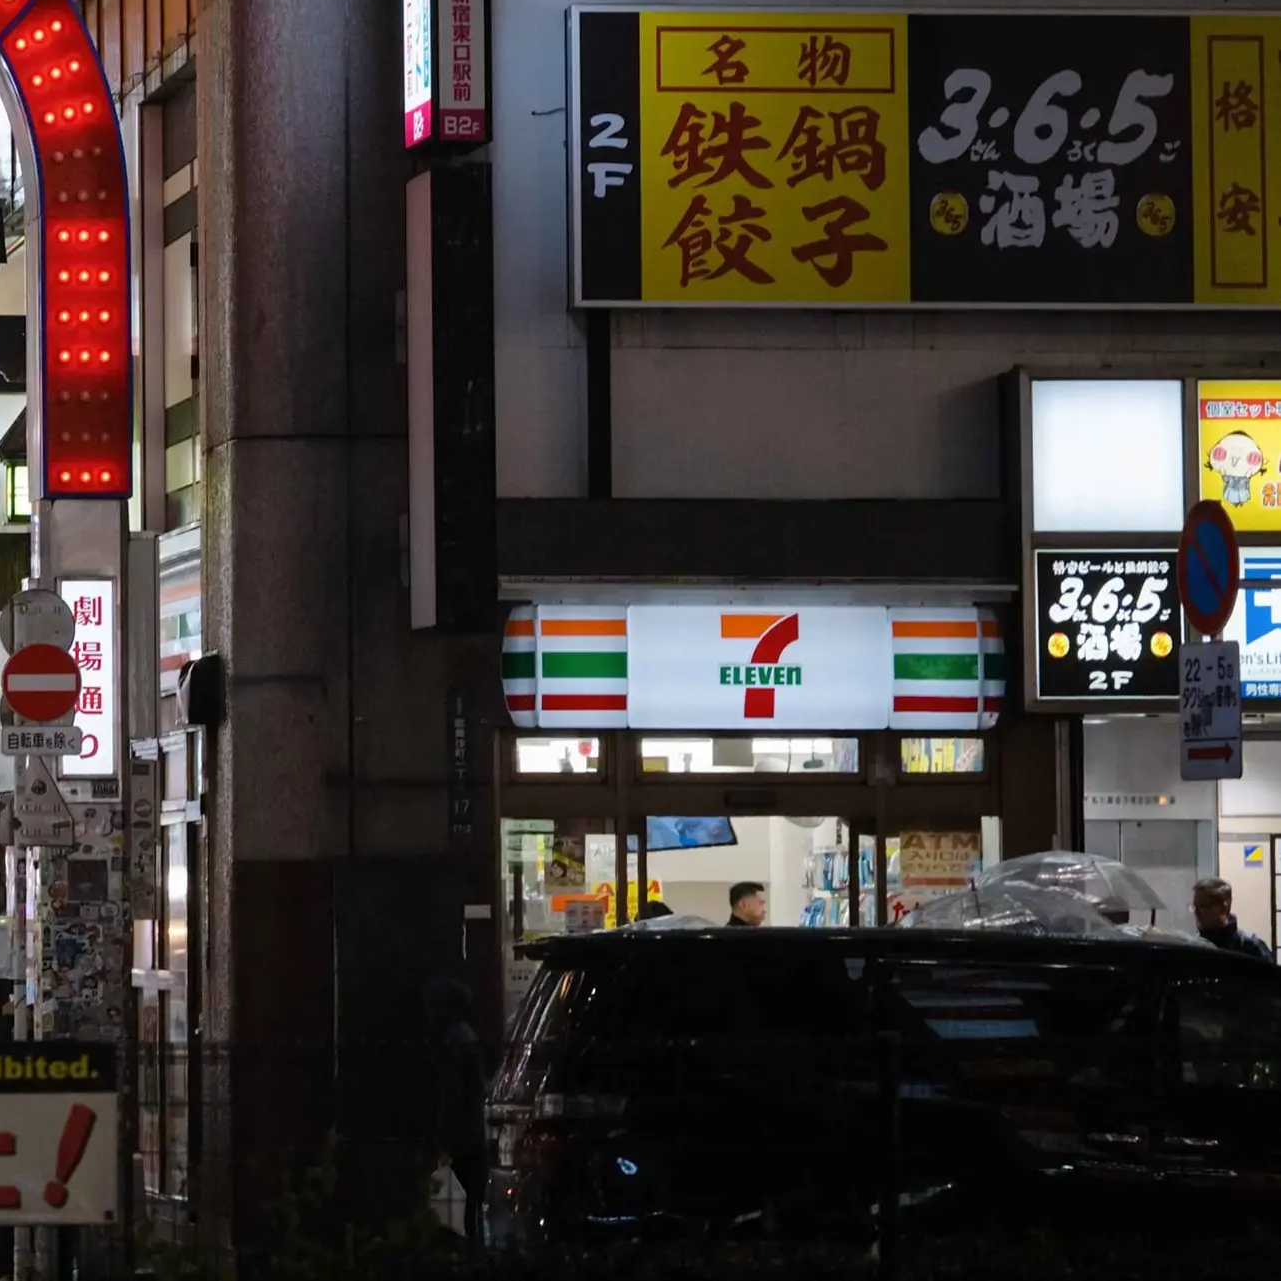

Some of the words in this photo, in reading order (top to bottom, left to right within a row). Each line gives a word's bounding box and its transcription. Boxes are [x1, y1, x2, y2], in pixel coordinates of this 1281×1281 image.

[701, 35, 854, 87] 名物
[444, 114, 481, 137] B2F
[659, 102, 888, 189] 鉄鍋
[1215, 81, 1261, 238] 格安
[662, 195, 889, 288] 餃子
[979, 169, 1121, 251] 酒場
[73, 595, 103, 759] 劇場通り
[1089, 670, 1134, 690] 2F
[7, 732, 76, 751] 自転車を除く
[903, 831, 980, 851] ATM
